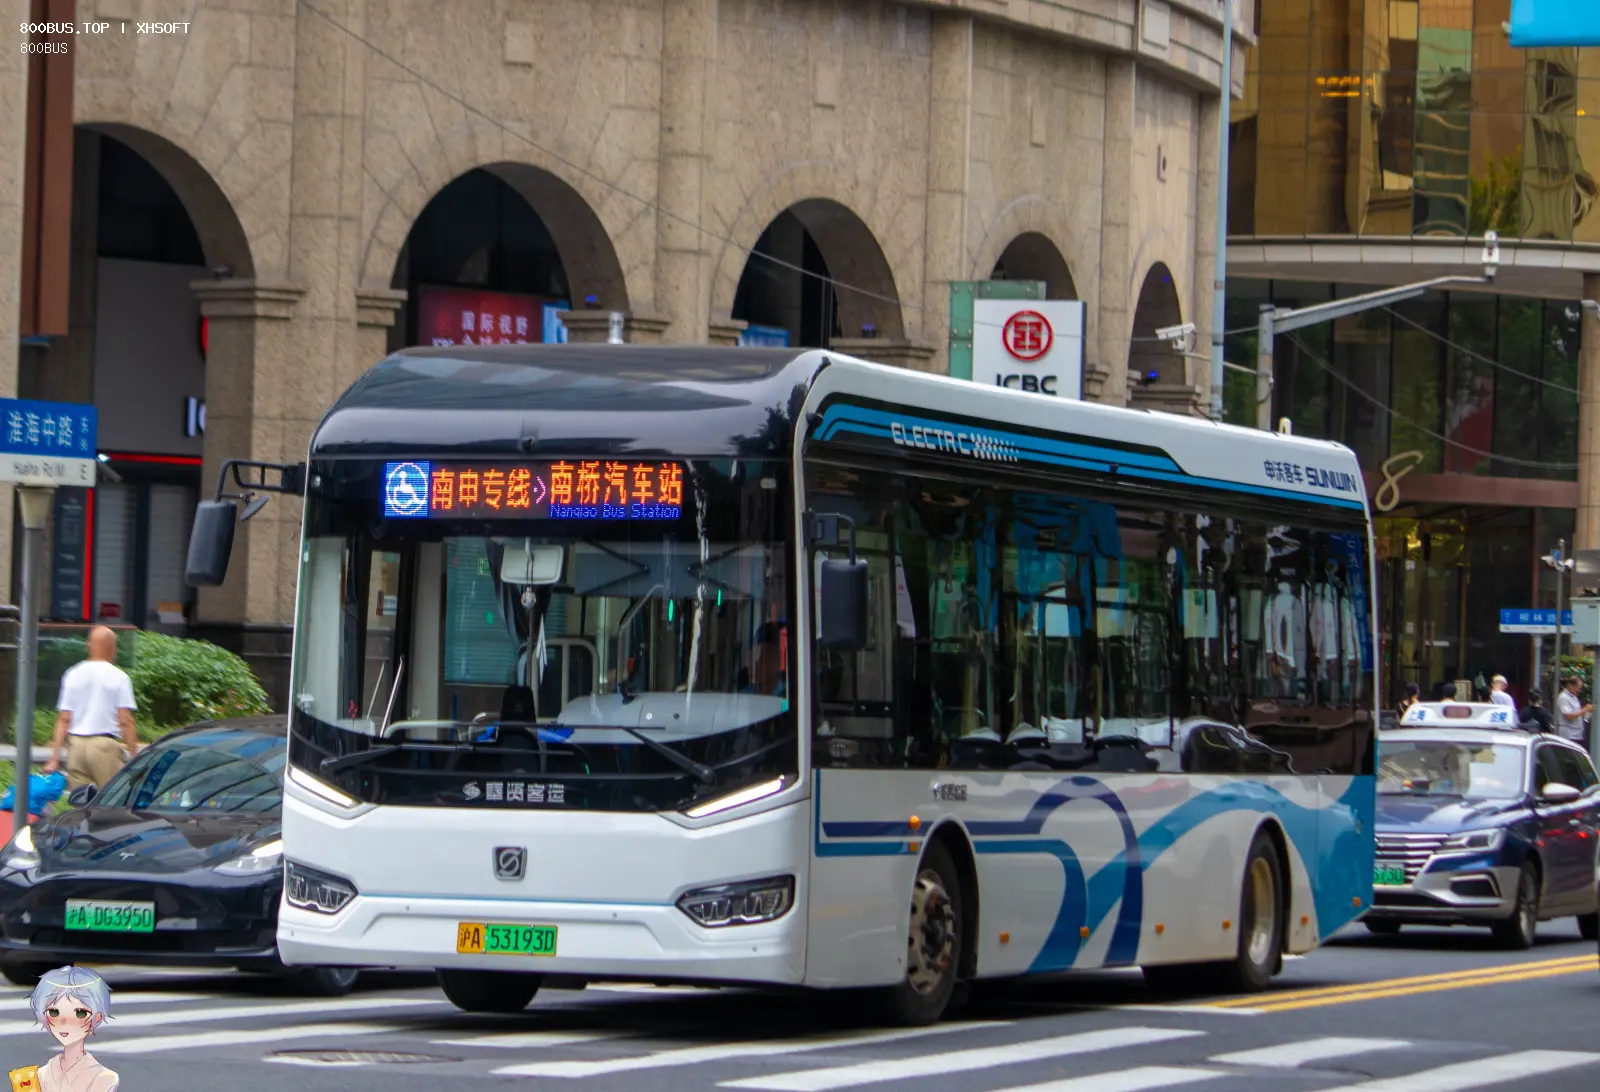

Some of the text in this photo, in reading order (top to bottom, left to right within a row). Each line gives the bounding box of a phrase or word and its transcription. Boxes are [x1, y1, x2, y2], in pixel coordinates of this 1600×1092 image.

[7, 409, 73, 447] 淮海中路
[431, 460, 682, 509] 南申专线 南桥汽车站
[1263, 459, 1357, 493] 申沃客车 SUNWIN
[550, 503, 679, 518] Nanqiao Bus Station
[94, 906, 152, 927] DG3950
[460, 927, 555, 951] 沪A 53193D
